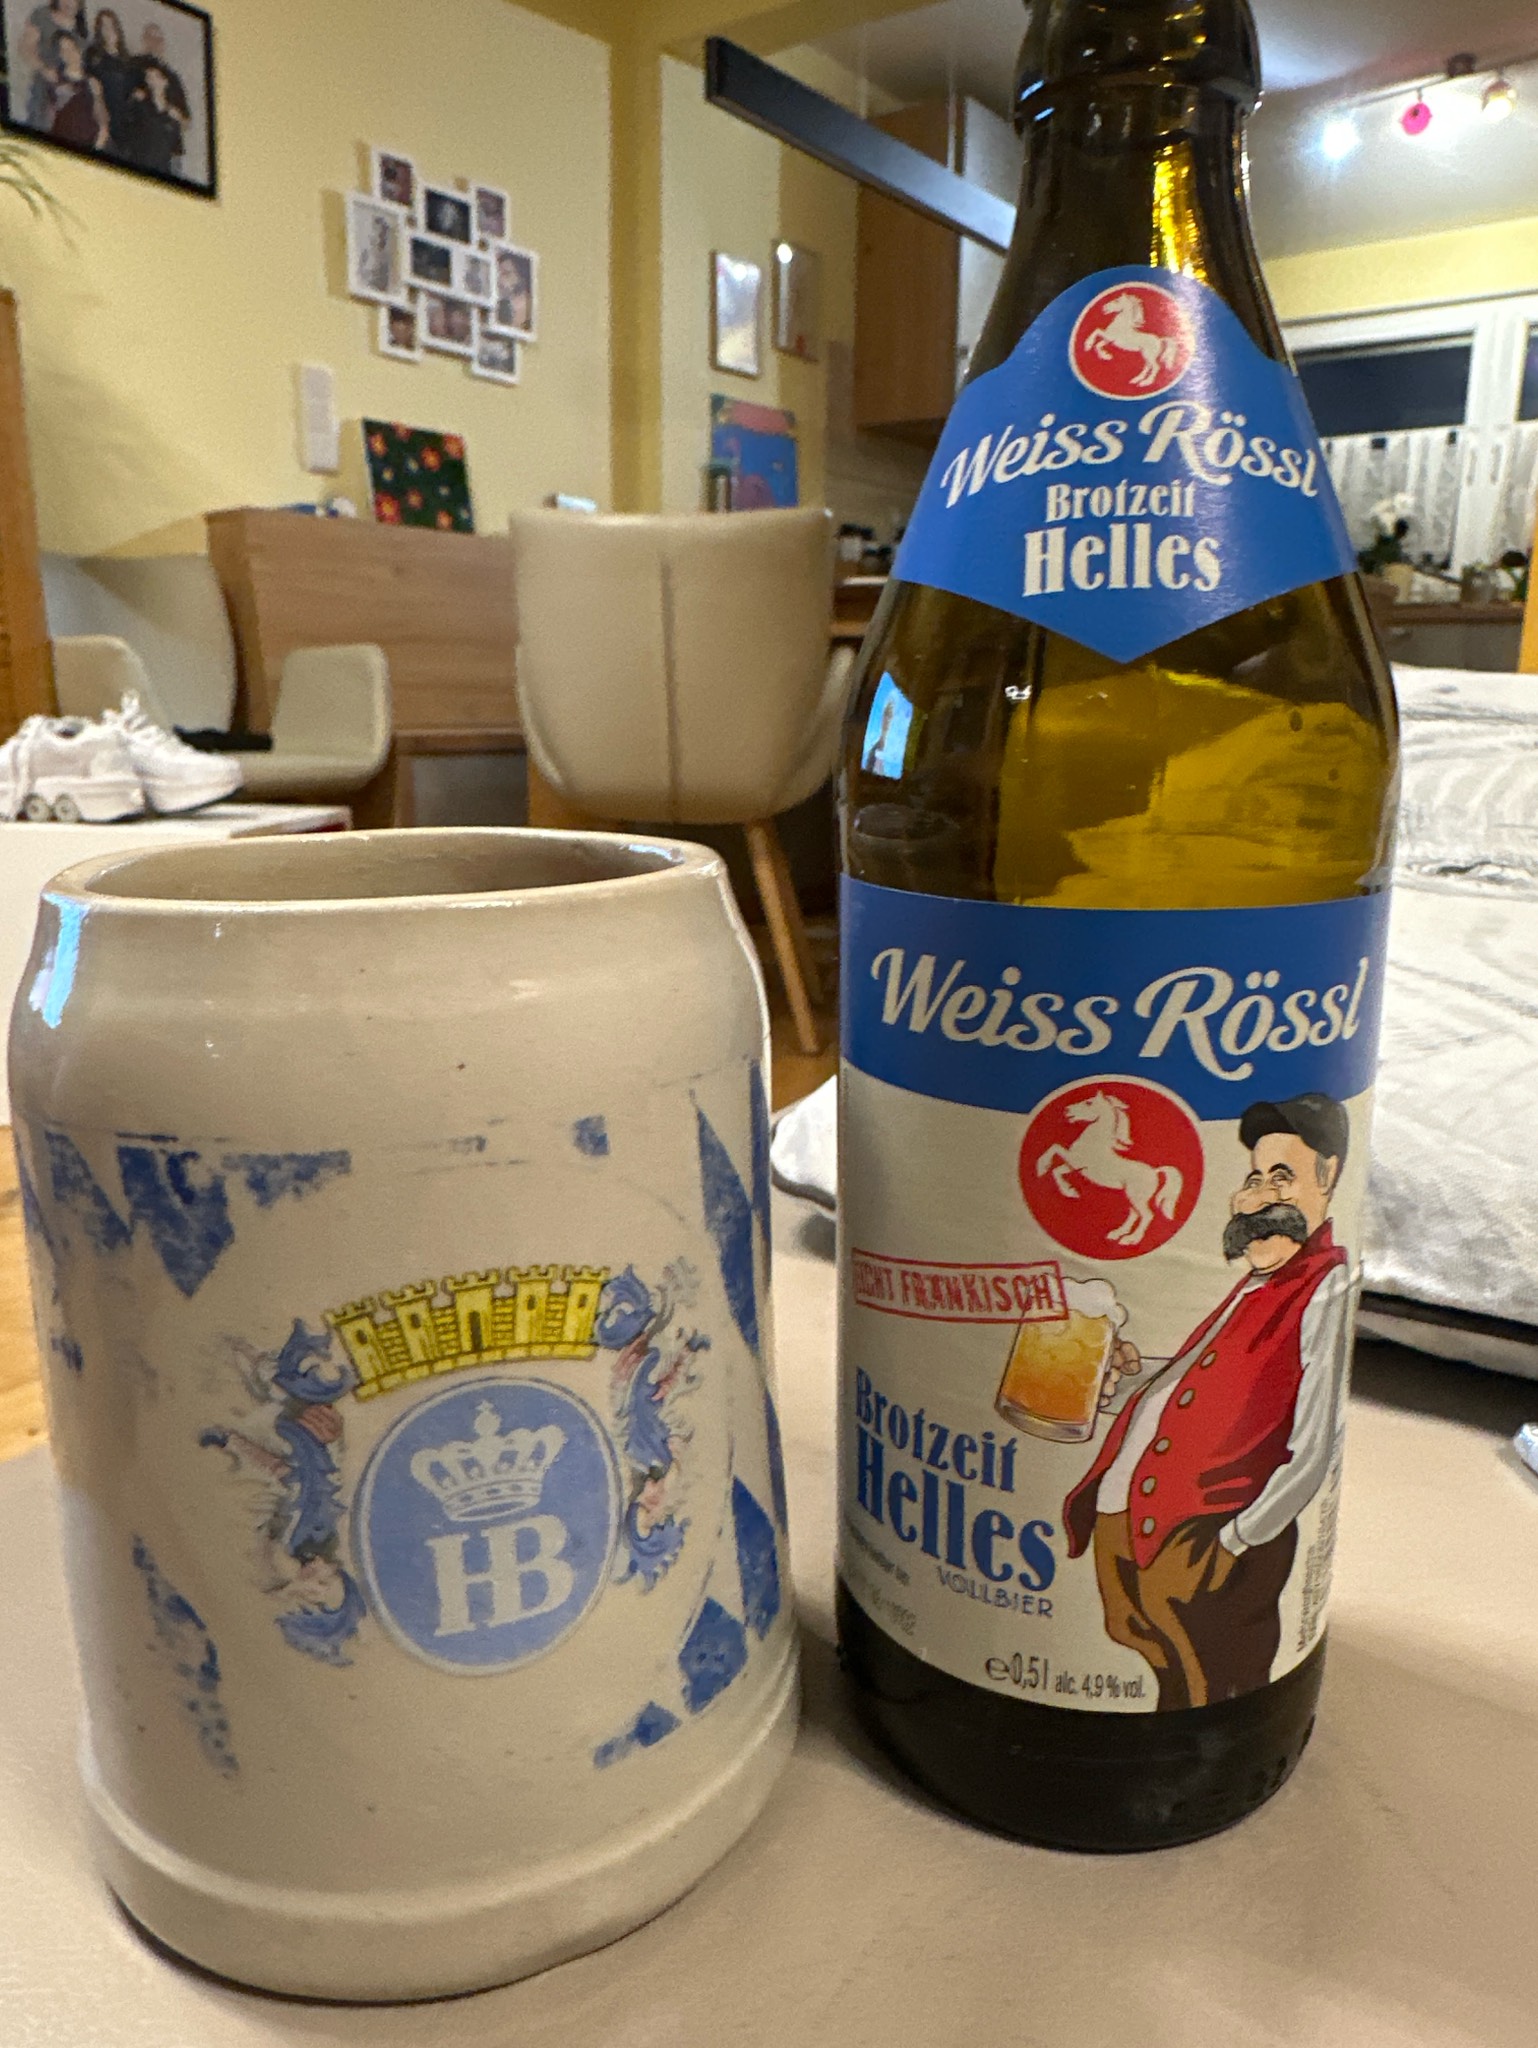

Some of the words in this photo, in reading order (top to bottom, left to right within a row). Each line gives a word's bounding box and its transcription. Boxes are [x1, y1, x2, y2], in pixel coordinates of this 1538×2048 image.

[940, 413, 1128, 508] Weiss
[1139, 400, 1319, 497] Rössl
[1045, 479, 1195, 523] Brotzeit
[1022, 523, 1221, 598] Helles
[870, 947, 1119, 1056] Weiss
[1134, 956, 1369, 1082] Rössl
[857, 1366, 1017, 1493] Brotzeit
[857, 1423, 1055, 1591] Helles
[424, 1514, 575, 1637] HB
[937, 1565, 1054, 1616] VOLLBIER
